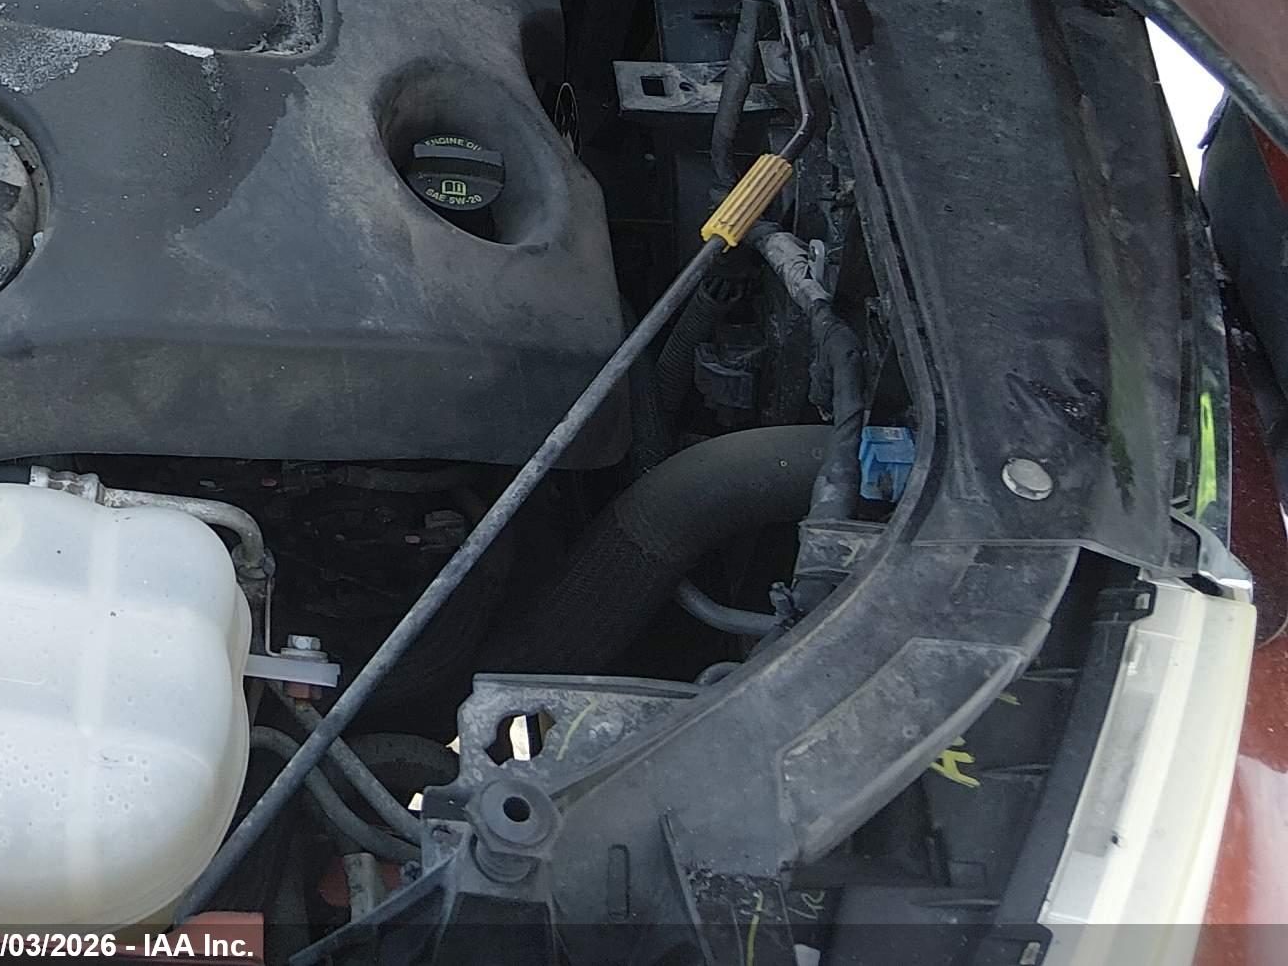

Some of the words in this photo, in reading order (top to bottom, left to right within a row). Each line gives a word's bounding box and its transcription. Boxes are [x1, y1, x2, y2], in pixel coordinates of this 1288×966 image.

[424, 137, 464, 146] ENGINE
[425, 188, 446, 202] SAE
[448, 195, 482, 205] 5W-20
